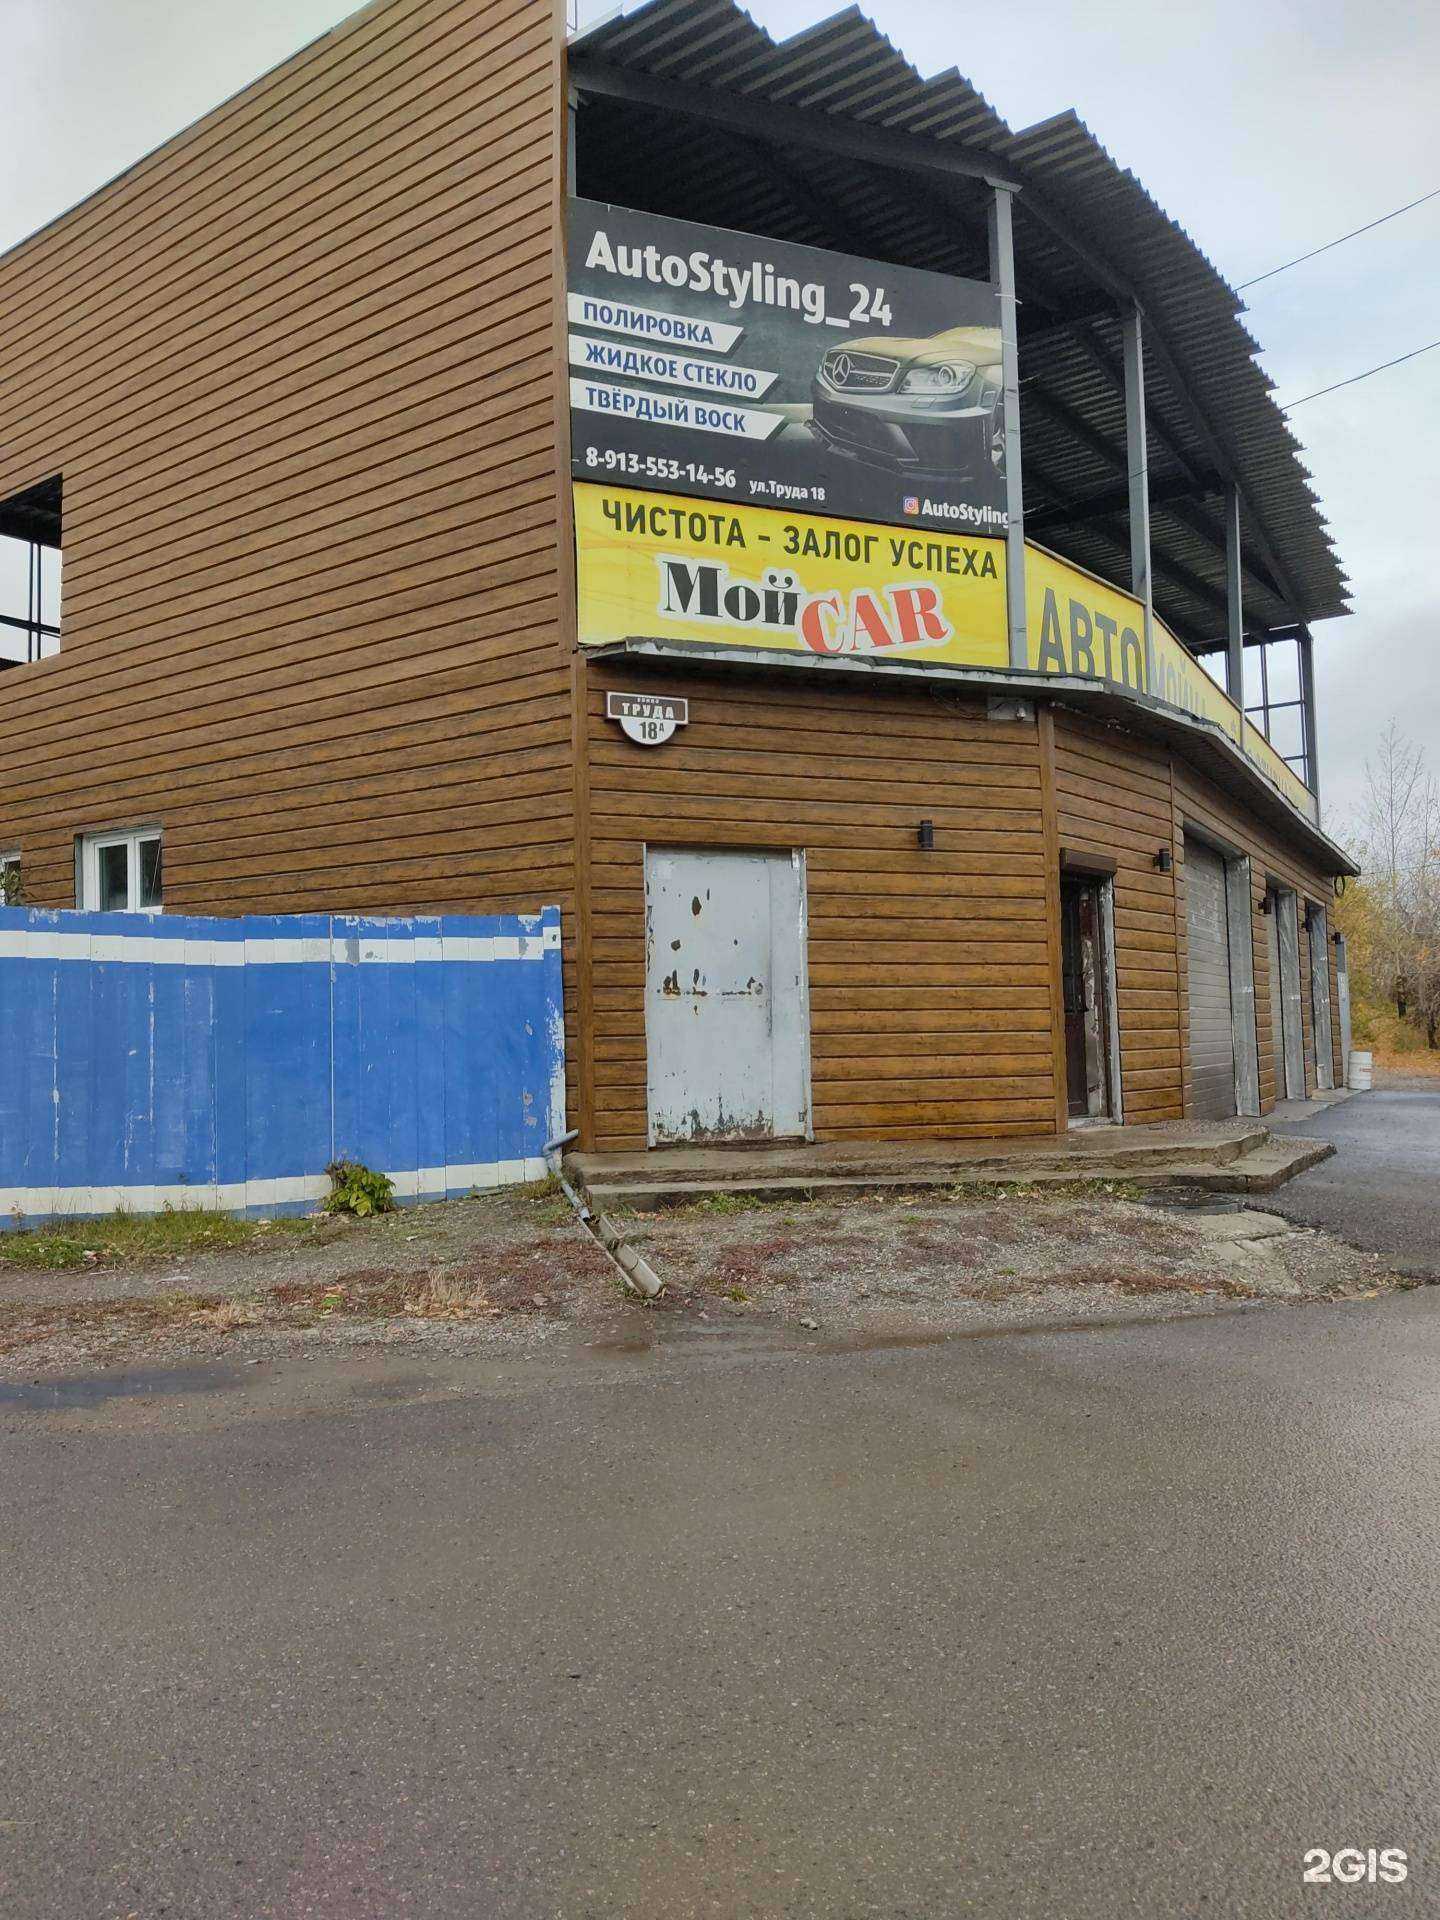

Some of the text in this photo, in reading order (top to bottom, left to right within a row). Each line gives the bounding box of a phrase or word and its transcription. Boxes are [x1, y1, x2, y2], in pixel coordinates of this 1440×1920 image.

[585, 230, 892, 328] AutoStyling_24
[584, 302, 714, 345] ПОЛИРОВКА
[586, 343, 757, 392] ЖИДКОЕ СТЕКЛО
[586, 387, 746, 432] ТВЁРДЫЙ ВОСК
[586, 447, 736, 488] 8-913-553-14-56
[811, 487, 826, 501] 18
[602, 499, 746, 549] ЧИСТОТА
[783, 525, 879, 564] ЗАЛОГ
[889, 538, 998, 579] УСПЕХА
[622, 702, 674, 719] ТРУДА
